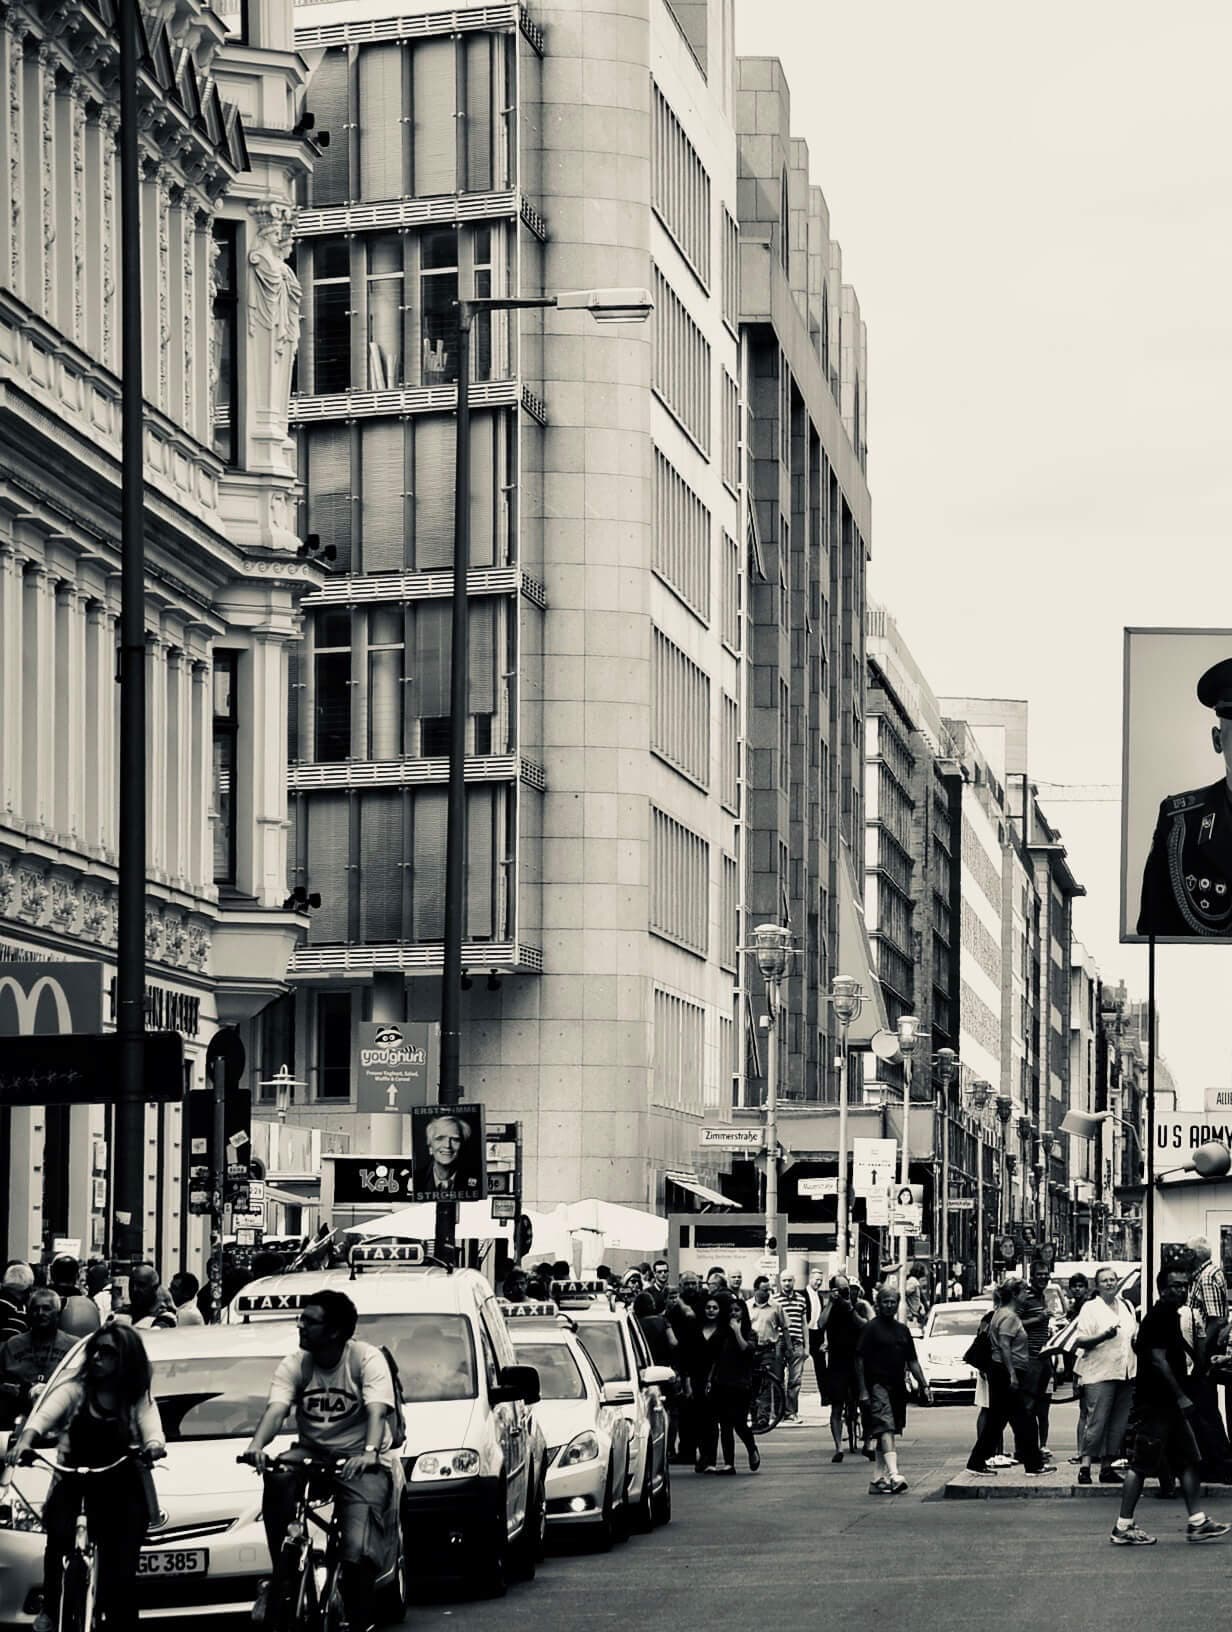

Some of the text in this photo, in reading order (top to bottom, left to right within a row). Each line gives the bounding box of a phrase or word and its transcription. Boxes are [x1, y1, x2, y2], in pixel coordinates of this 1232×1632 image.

[705, 1131, 758, 1142] Zimmerstraße
[361, 1247, 411, 1259] TAXI
[560, 1281, 597, 1291] TAXI
[247, 1295, 300, 1309] TAXI
[505, 1305, 548, 1316] TAXI
[307, 1397, 346, 1413] FILA
[163, 1552, 198, 1573] 385
